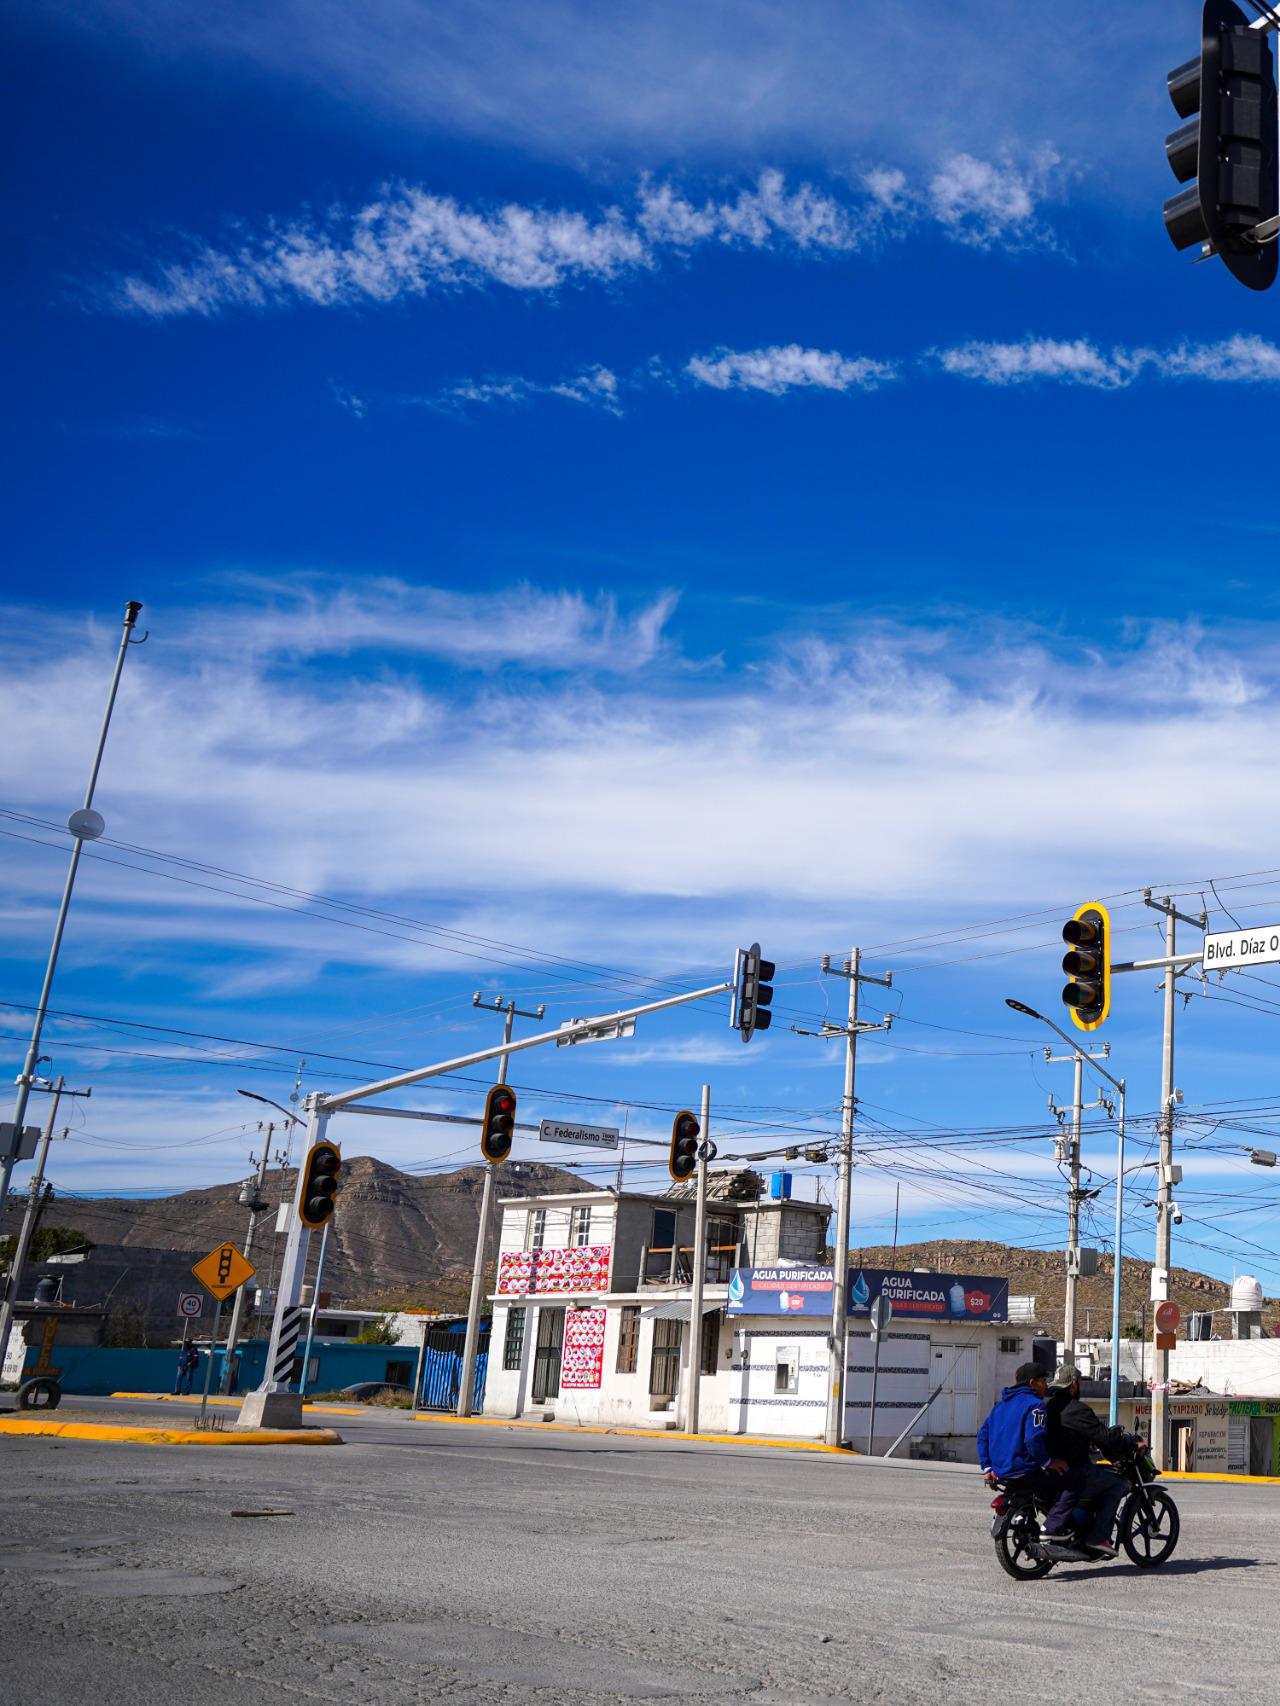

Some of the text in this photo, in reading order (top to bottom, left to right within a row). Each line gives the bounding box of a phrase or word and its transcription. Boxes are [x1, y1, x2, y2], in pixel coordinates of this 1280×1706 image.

[1207, 940, 1236, 960] Blvd.
[1240, 938, 1265, 956] Díaz
[544, 1126, 552, 1137] C.
[554, 1127, 600, 1142] Federalismo
[752, 1270, 833, 1281] AGUA PURIFICADA
[881, 1276, 913, 1288] AGUA
[881, 1288, 946, 1302] PURIFICADA
[970, 1298, 984, 1306] $20
[1173, 1405, 1203, 1415] TAPIZADO
